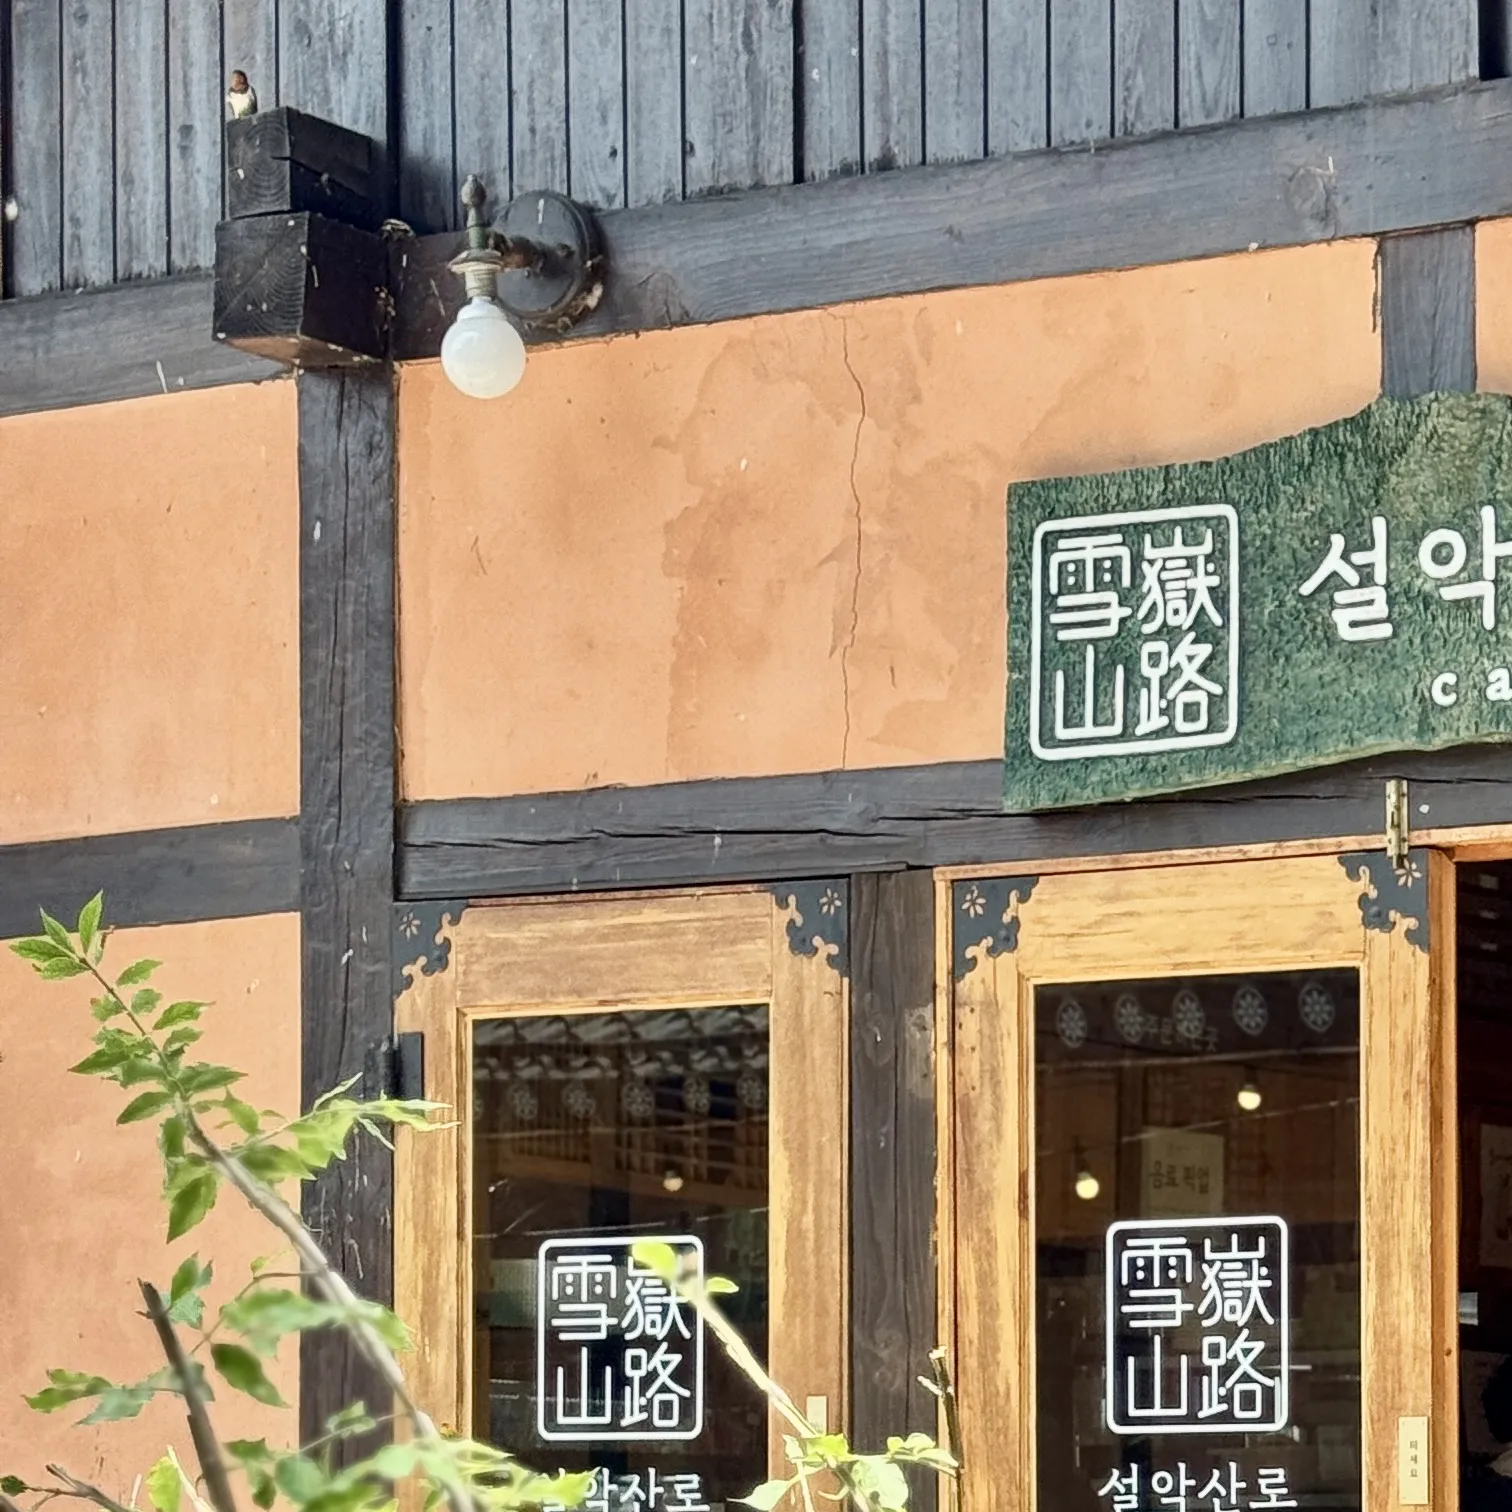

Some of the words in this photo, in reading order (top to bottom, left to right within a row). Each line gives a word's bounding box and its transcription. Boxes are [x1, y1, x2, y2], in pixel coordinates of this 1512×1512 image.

[1053, 631, 1223, 739] 山路
[556, 1341, 692, 1428] 山路
[1127, 1328, 1276, 1419] 山路
